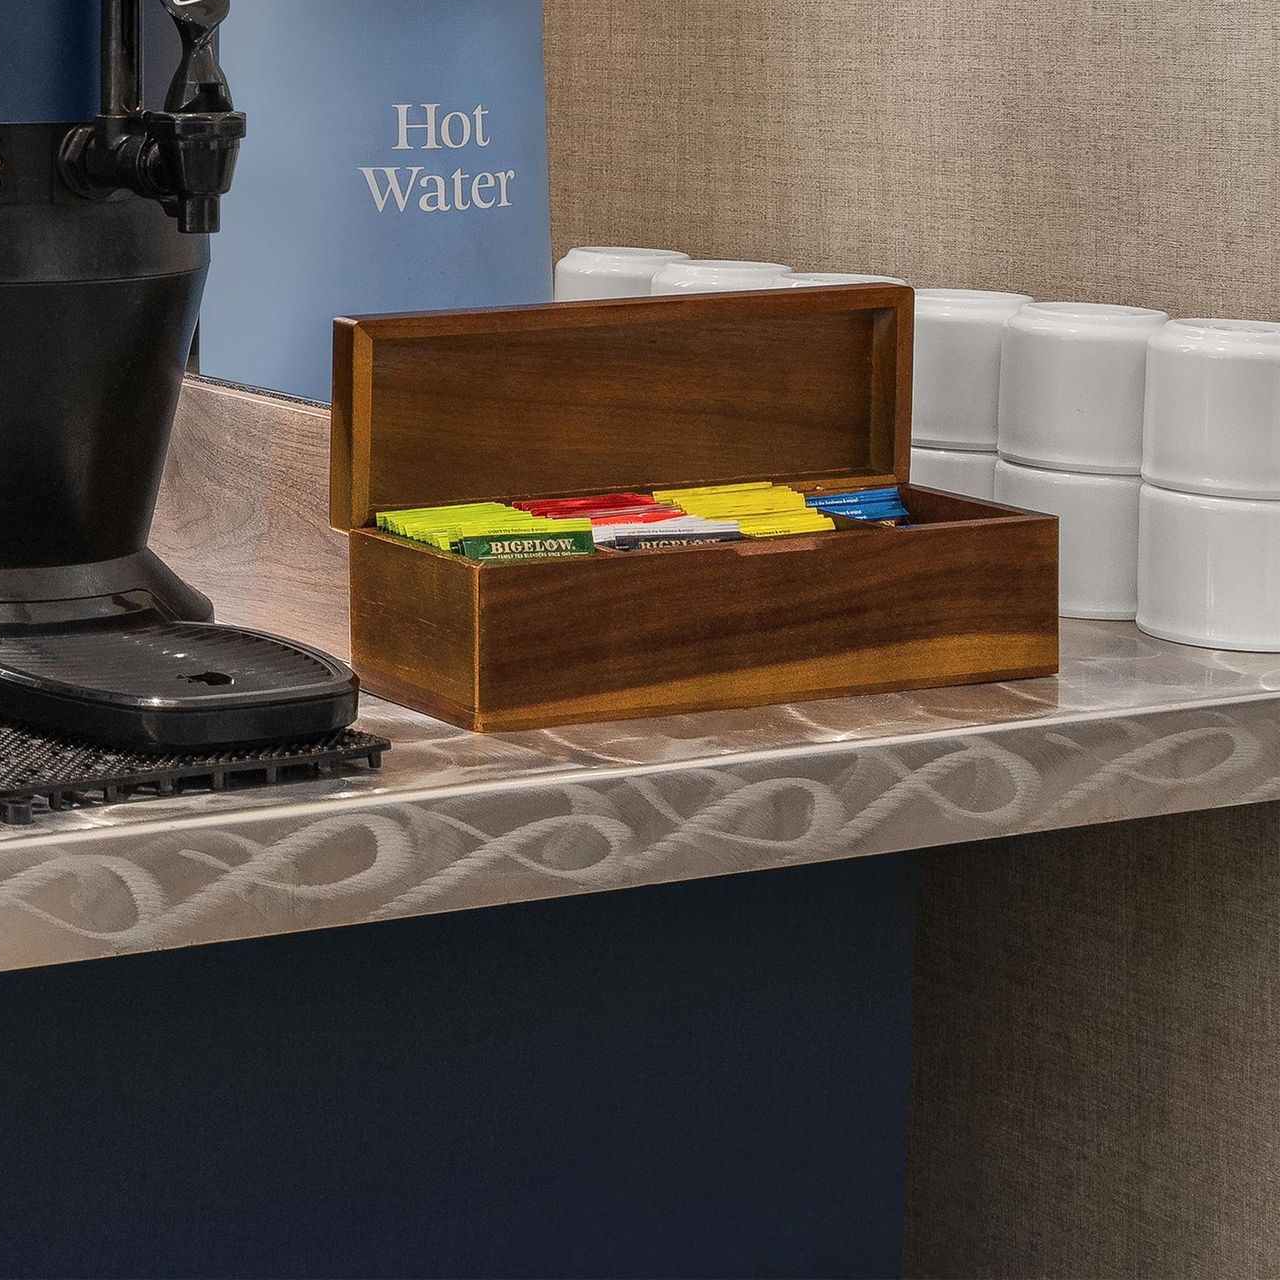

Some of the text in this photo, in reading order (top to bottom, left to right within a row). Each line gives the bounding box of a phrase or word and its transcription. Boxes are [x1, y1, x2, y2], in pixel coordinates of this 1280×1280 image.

[391, 103, 490, 150] Hot
[357, 166, 515, 213] Water
[490, 539, 574, 555] BIGELOW
